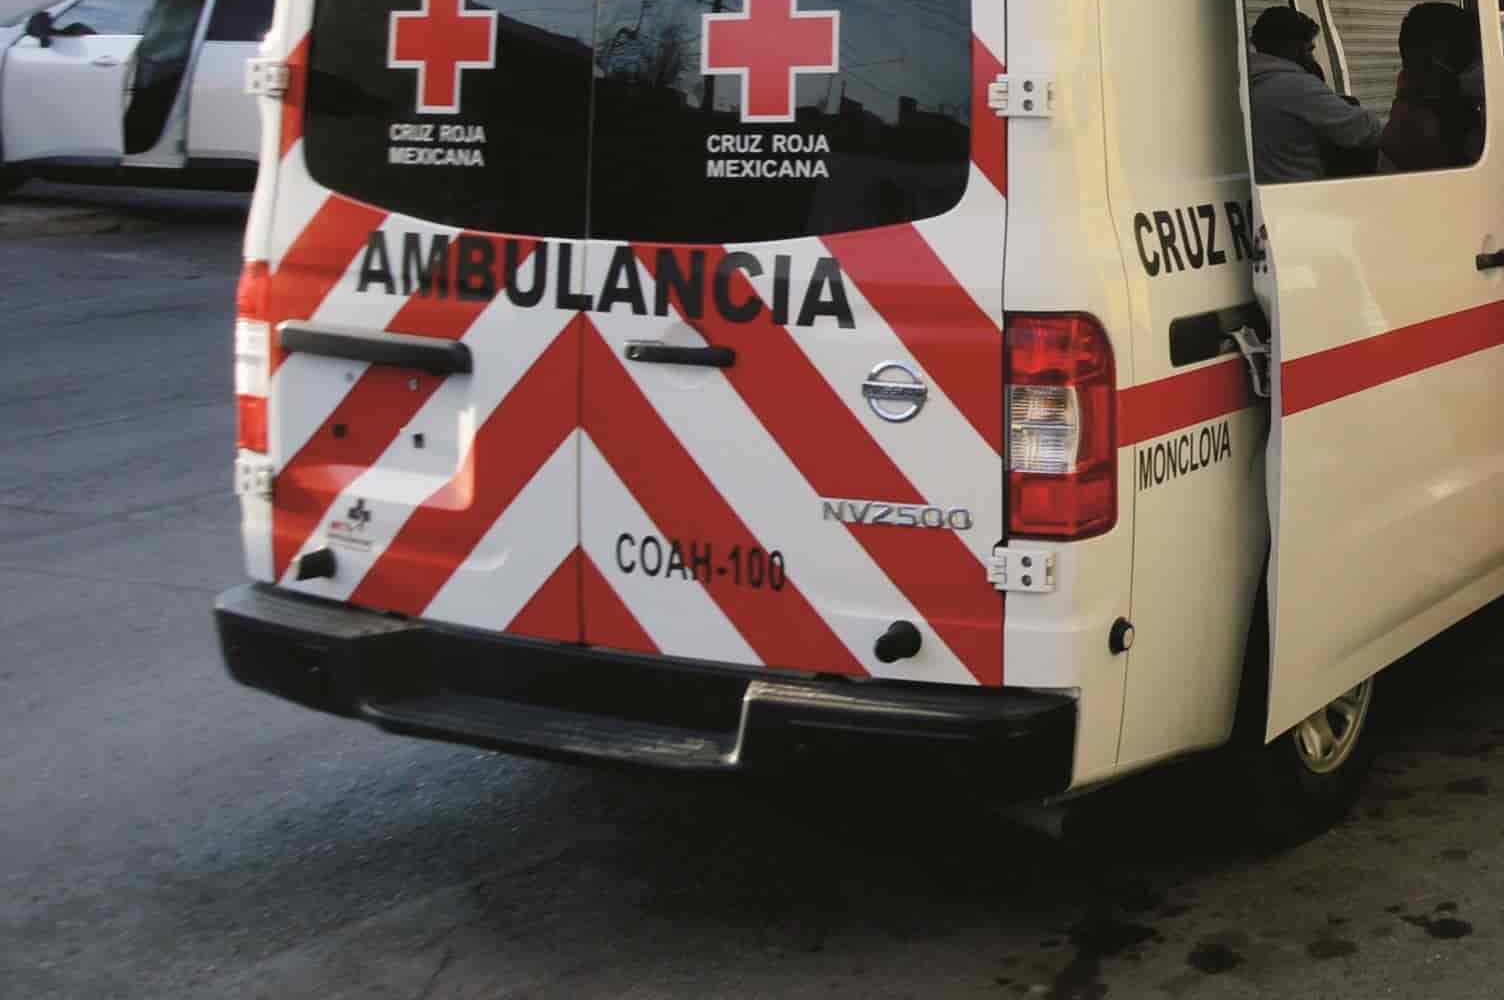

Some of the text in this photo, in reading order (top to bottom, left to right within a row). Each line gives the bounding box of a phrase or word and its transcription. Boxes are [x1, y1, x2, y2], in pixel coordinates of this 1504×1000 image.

[389, 124, 486, 144] CRUZ ROJA
[707, 135, 830, 153] CRUZ ROJA
[388, 147, 485, 167] MEXICANA
[707, 160, 830, 179] MEXICANA
[1134, 203, 1226, 277] CRUZ
[357, 229, 857, 330] AMBULANCIA
[1139, 420, 1232, 491] MONCLOVA
[822, 500, 974, 531] NV2500
[615, 532, 786, 592] COAH-100
